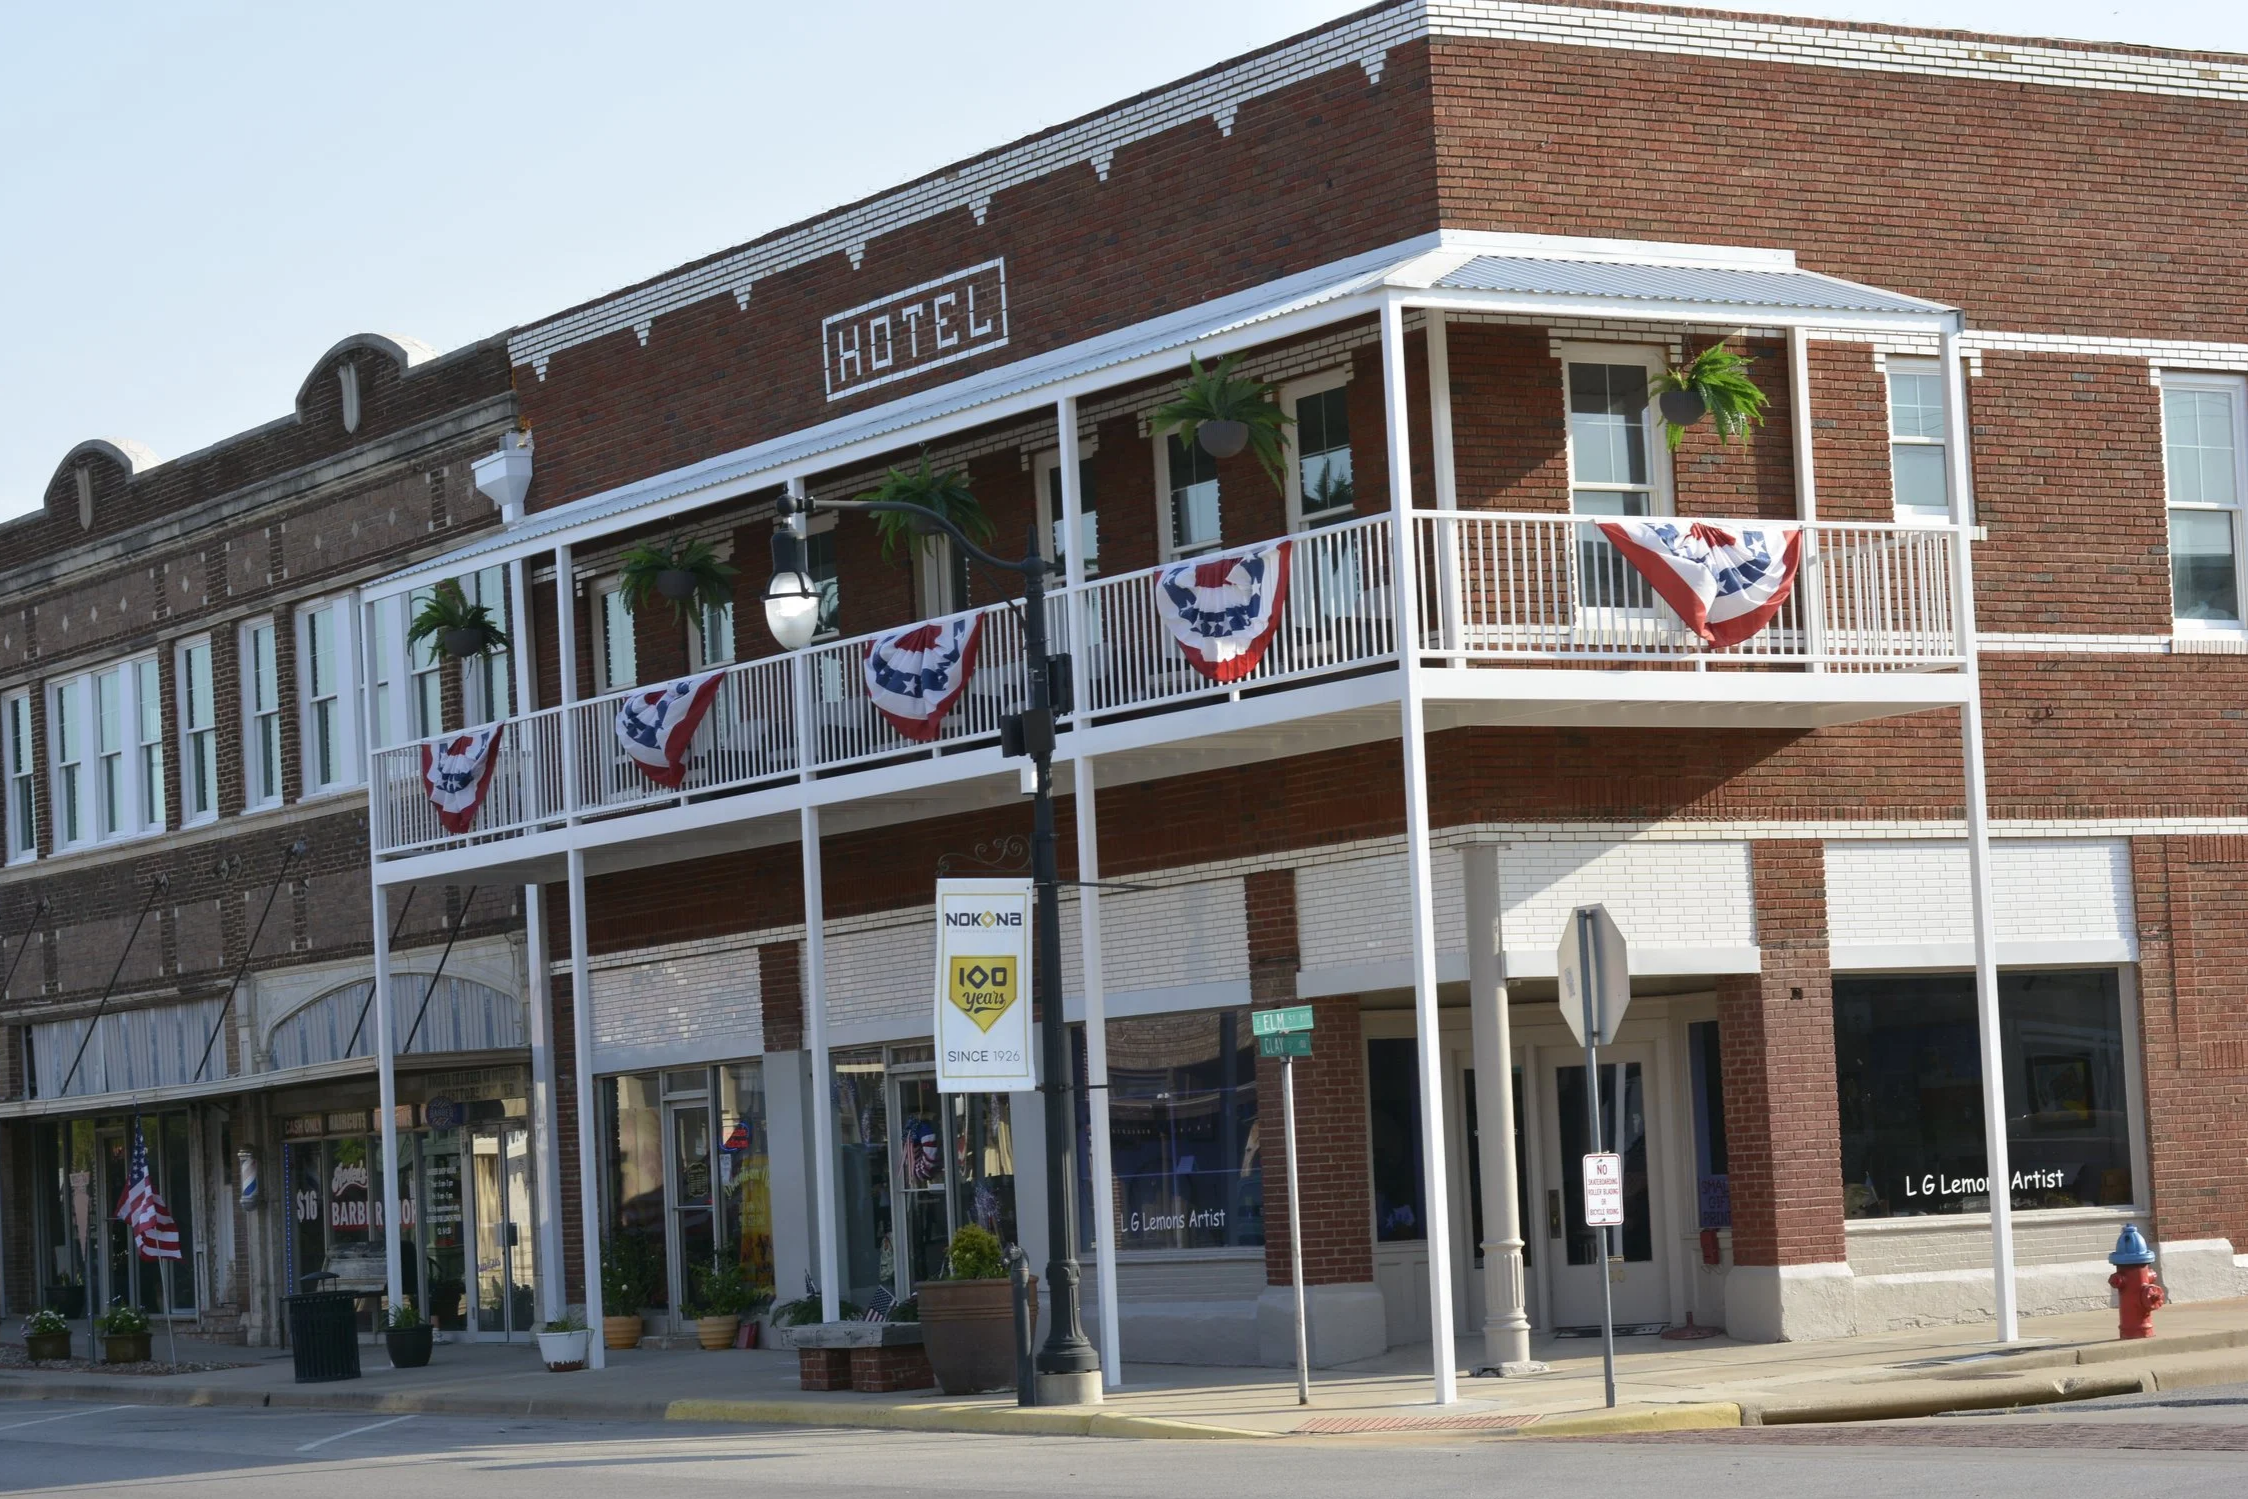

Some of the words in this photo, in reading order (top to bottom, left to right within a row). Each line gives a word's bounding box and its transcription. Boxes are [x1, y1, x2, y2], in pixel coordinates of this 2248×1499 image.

[838, 285, 992, 382] HOTEL
[959, 965, 1007, 989] 100
[962, 991, 1006, 1013] years
[1263, 1012, 1285, 1032] ELM
[1264, 1037, 1284, 1054] CLAY
[948, 1051, 988, 1062] SINCE
[993, 1051, 1020, 1062] 1926
[284, 1119, 303, 1135] CASH
[305, 1117, 322, 1134] ONLY
[328, 1111, 367, 1131] HAIRCUTS
[1597, 1164, 1607, 1175] NO
[1701, 1180, 1729, 1194] SMAL
[1906, 1175, 1917, 1197] L
[1922, 1174, 1935, 1195] G
[1941, 1174, 1990, 1195] Lemo
[2011, 1169, 2064, 1190] Artist
[297, 1188, 318, 1223] $16
[1120, 1213, 1128, 1232] L
[1130, 1212, 1139, 1232] G
[1142, 1212, 1185, 1231] Lemons
[1189, 1208, 1226, 1228] Artist
